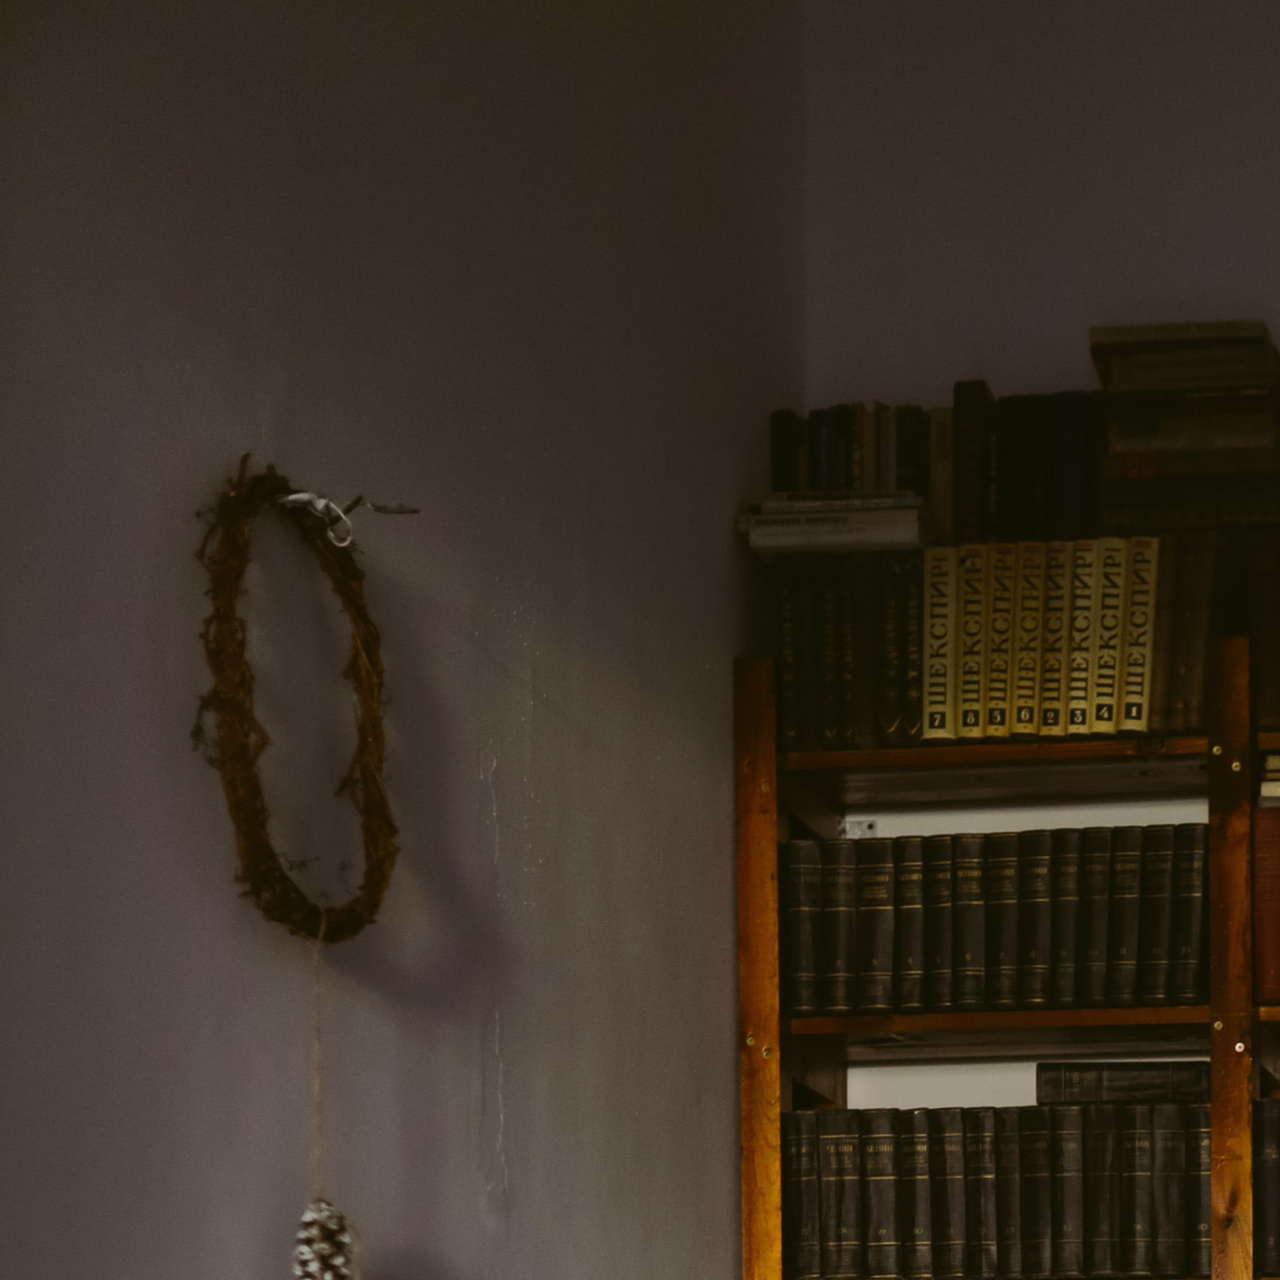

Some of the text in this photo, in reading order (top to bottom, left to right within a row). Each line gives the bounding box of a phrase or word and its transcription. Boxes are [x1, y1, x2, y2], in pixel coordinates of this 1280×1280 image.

[988, 558, 1012, 701] ШЕКСПИР
[1018, 557, 1039, 699] ШЕКСПИР
[1043, 556, 1064, 702] ШЕКСПИР
[1070, 556, 1091, 701] ШЕКСПИР
[1096, 556, 1120, 698] ШЕКСПИР
[1125, 552, 1151, 697] ШЕКСПИР
[930, 564, 949, 706] ШЕКСПИР
[966, 712, 976, 724] 8
[992, 710, 1002, 723] 5
[1021, 708, 1030, 721] 6
[1046, 710, 1056, 723] 2
[1074, 710, 1083, 722] 3
[1099, 706, 1109, 719] 4
[1129, 705, 1138, 718] 1
[933, 714, 942, 726] 7
